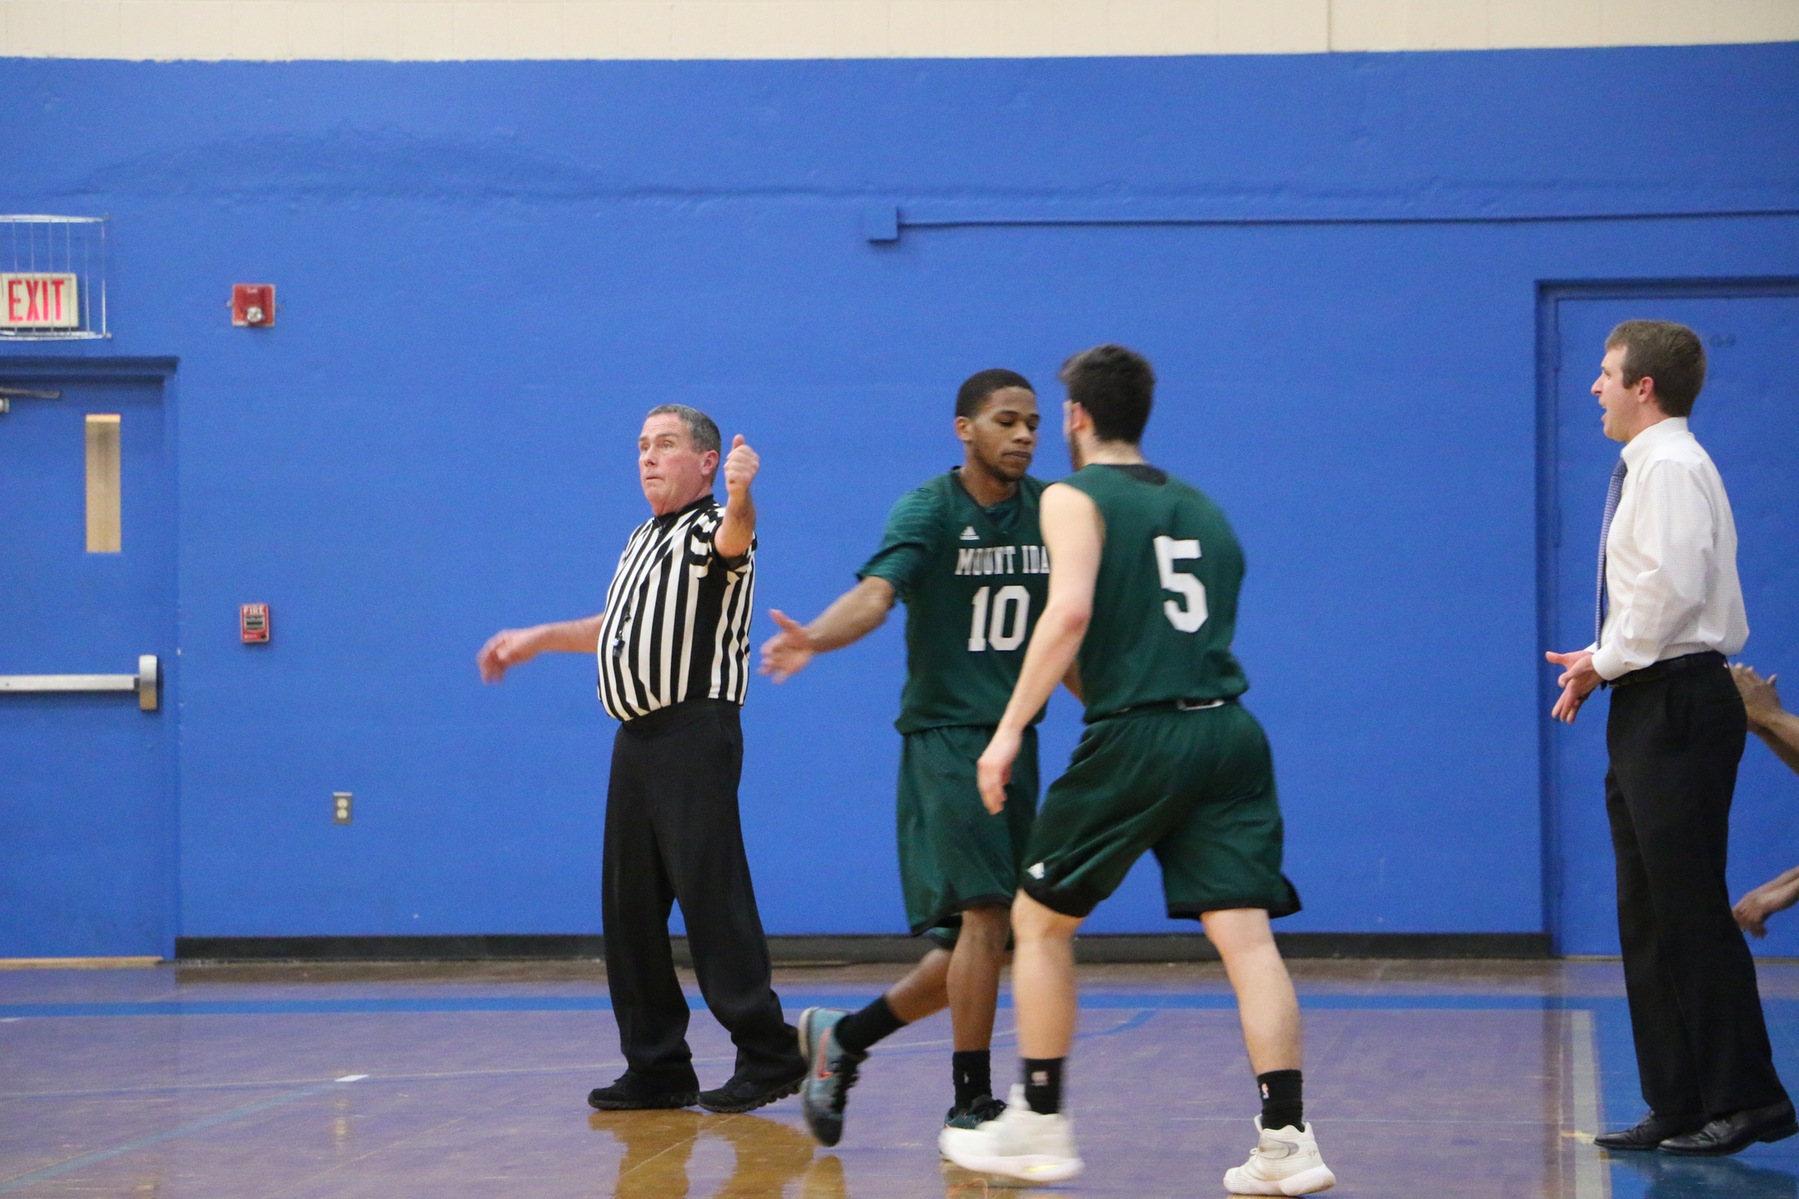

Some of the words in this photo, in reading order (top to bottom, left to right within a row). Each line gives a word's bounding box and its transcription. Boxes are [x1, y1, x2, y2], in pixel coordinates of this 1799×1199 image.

[8, 279, 65, 321] EXIT
[954, 546, 1015, 575] MOUNT
[1152, 535, 1208, 633] 5
[243, 604, 264, 615] FIRE
[968, 585, 1030, 651] 10
